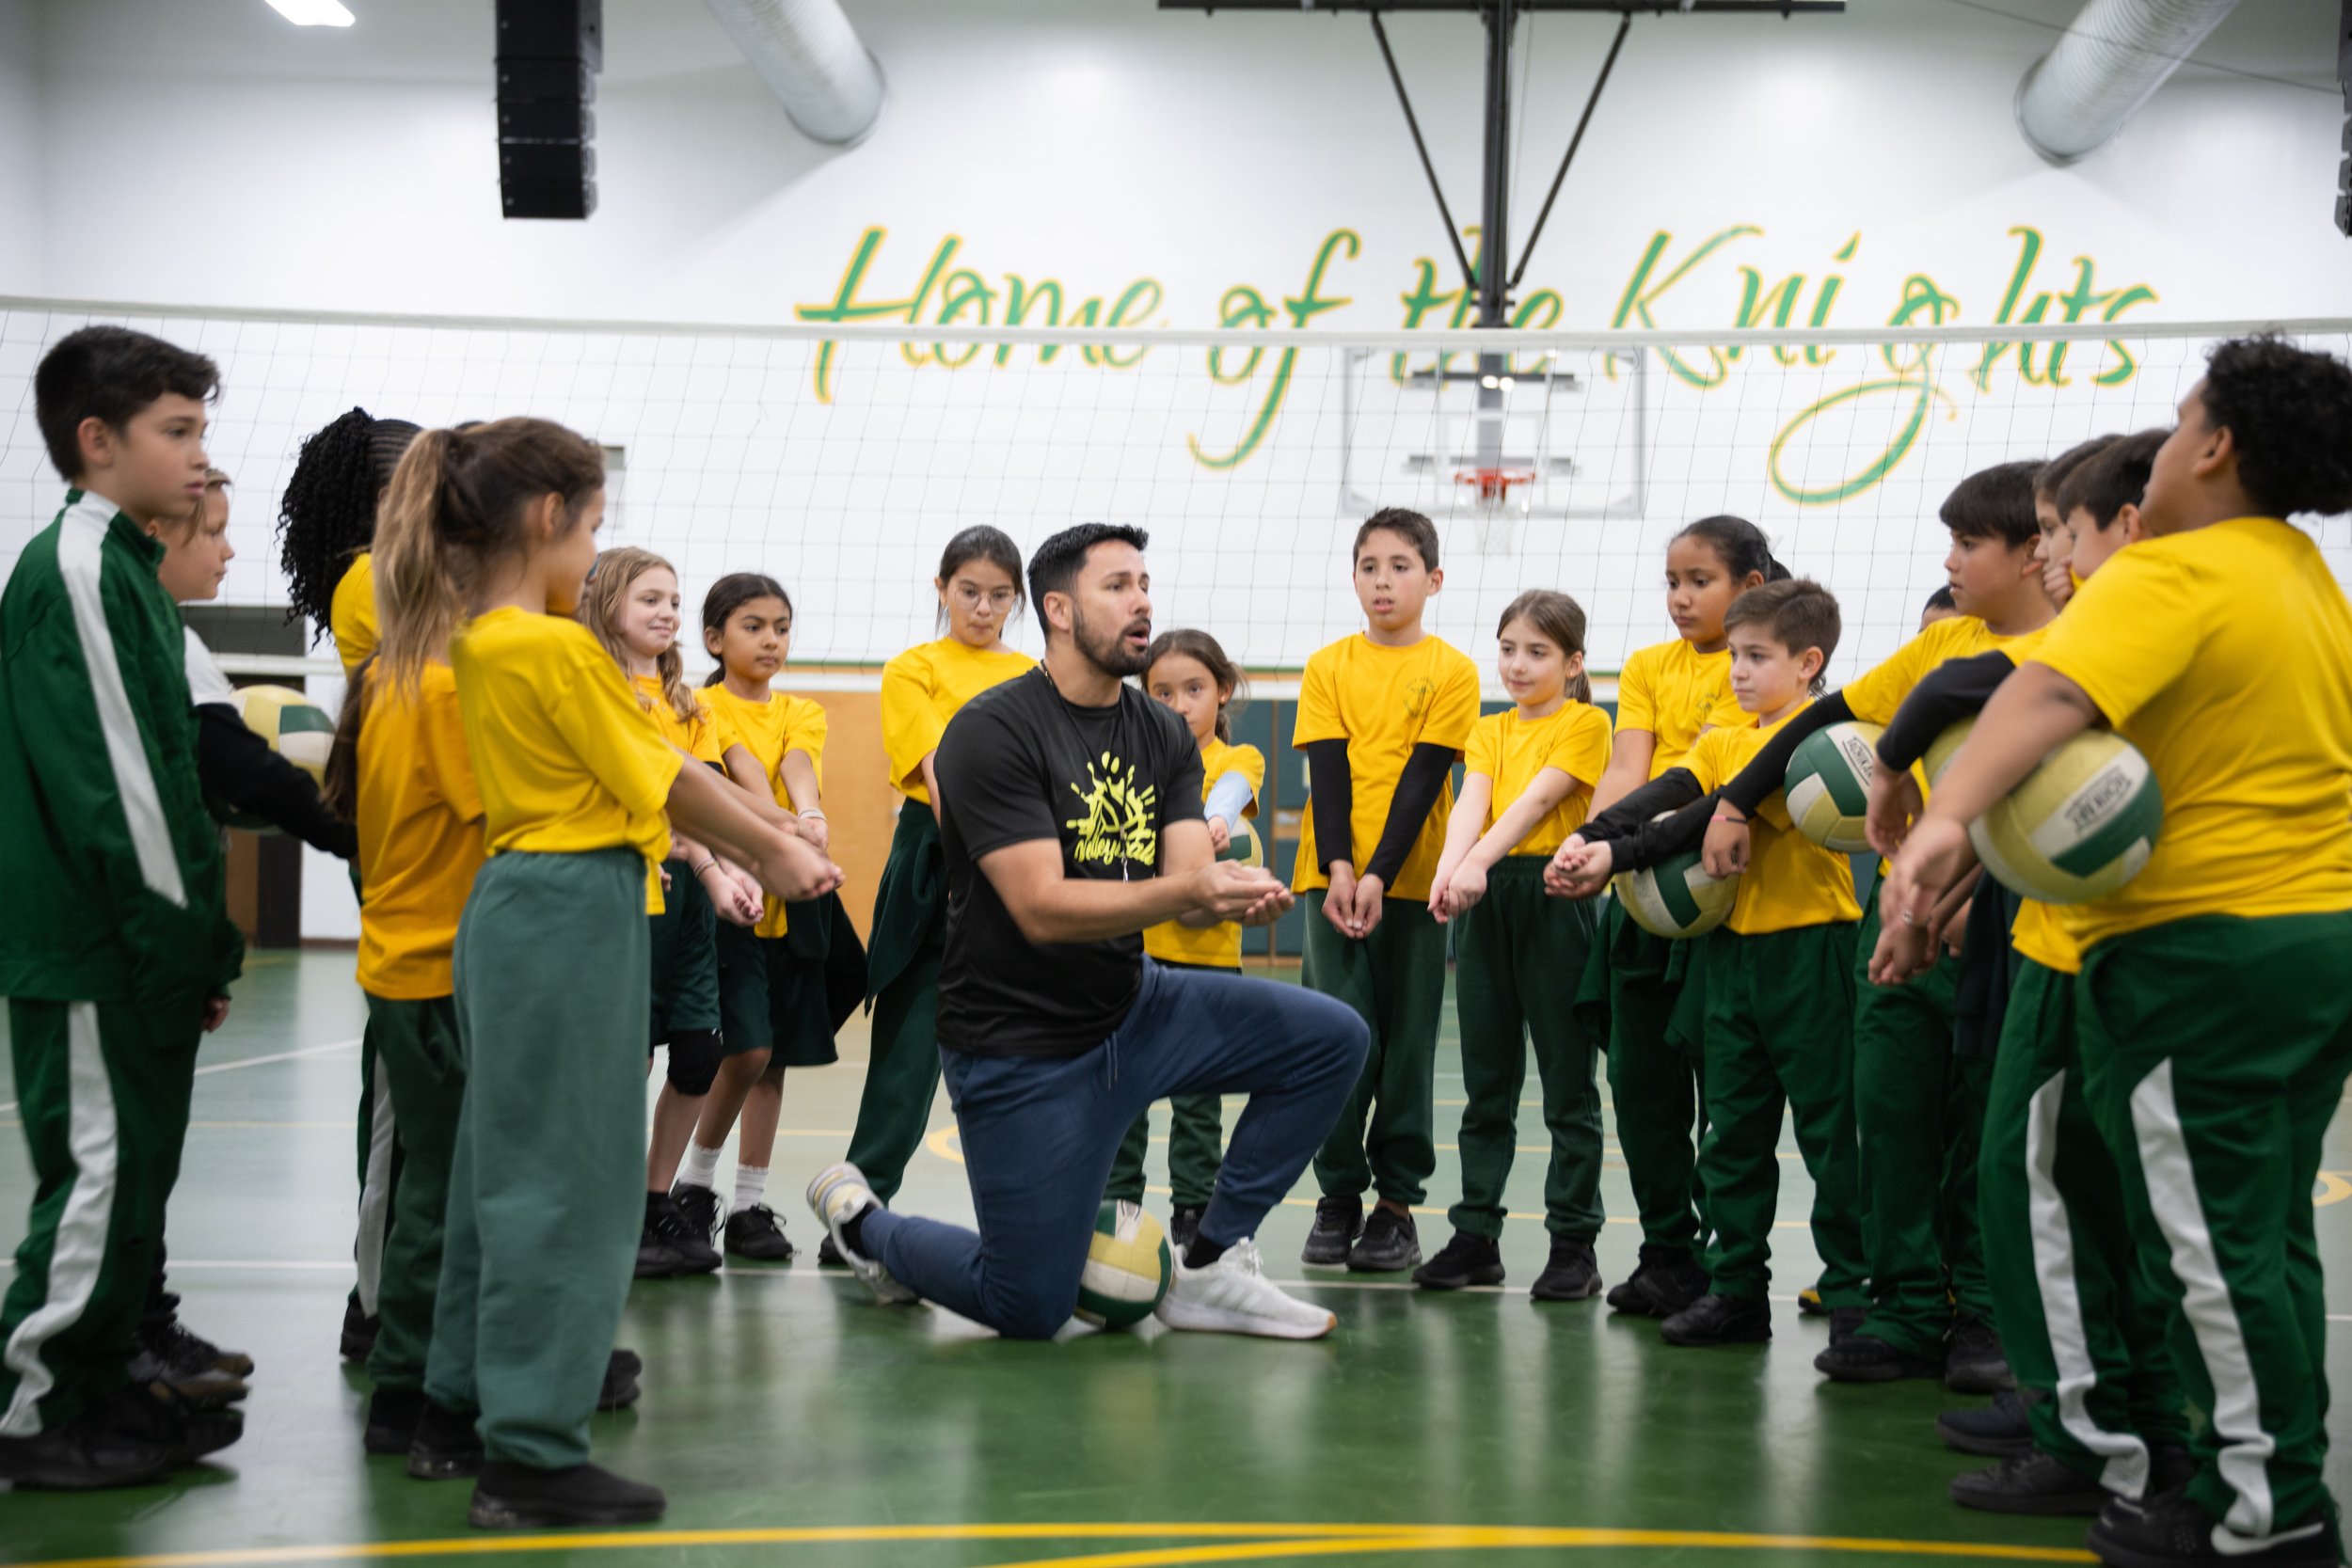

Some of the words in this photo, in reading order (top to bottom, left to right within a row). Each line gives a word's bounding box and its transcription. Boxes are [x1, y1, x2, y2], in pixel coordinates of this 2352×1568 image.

[793, 225, 1168, 404] Home
[1188, 228, 1362, 469] of
[1390, 225, 1565, 391] the
[1603, 225, 2160, 507] Knights
